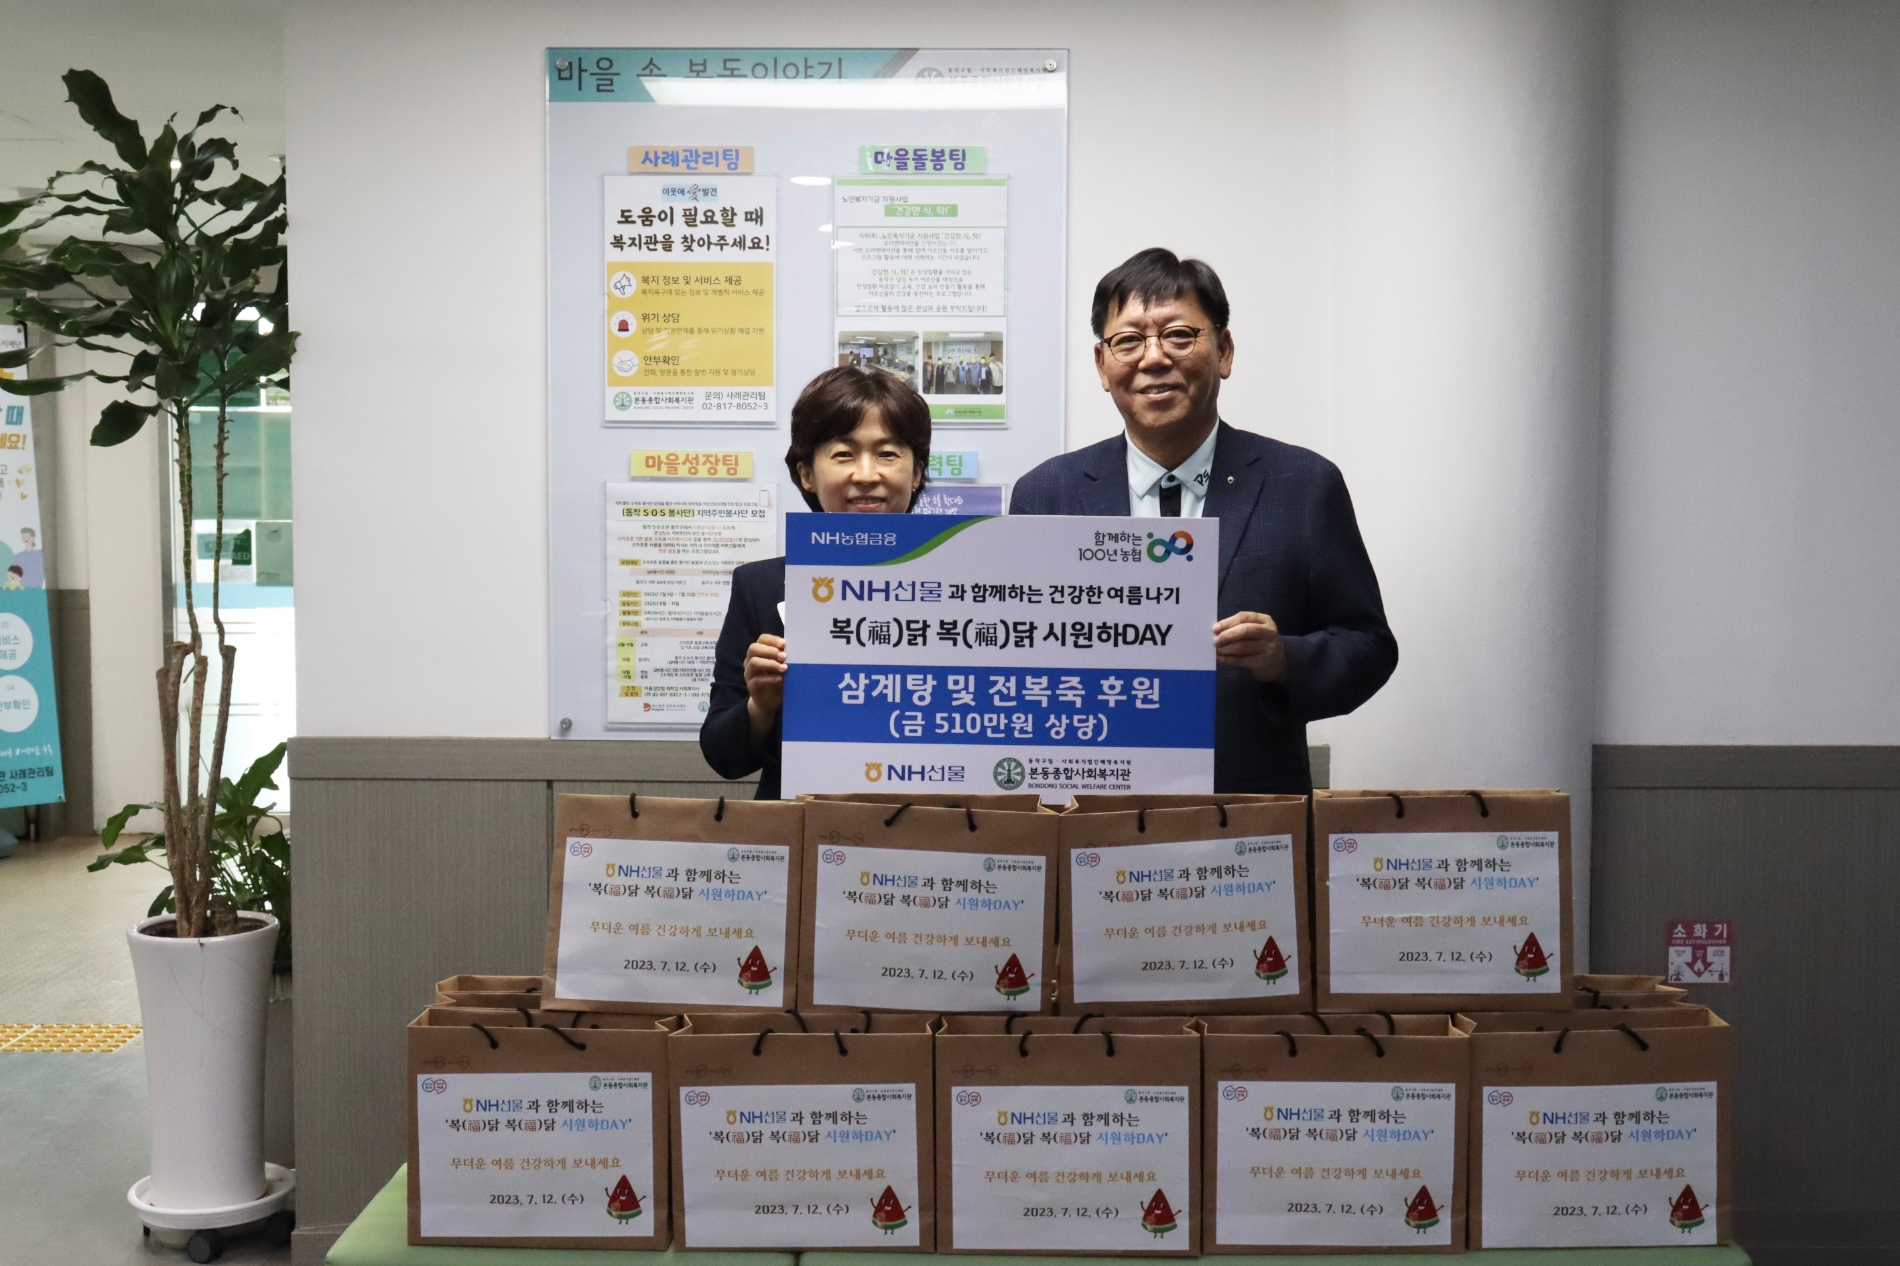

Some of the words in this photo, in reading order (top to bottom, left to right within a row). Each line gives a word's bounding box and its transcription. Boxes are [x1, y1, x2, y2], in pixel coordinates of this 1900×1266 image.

[641, 148, 740, 170] 사례관리팀
[874, 148, 966, 171] 마을돌봄팀
[702, 188, 717, 196] 발견
[617, 206, 674, 226] 도움이
[682, 206, 737, 227] 필요할
[745, 207, 763, 226] 때
[923, 206, 934, 216] 식,
[610, 234, 674, 252] 복지관을
[681, 234, 769, 252] 찾아주세요!
[641, 276, 659, 285] 복지
[662, 276, 680, 285] 정보
[683, 276, 691, 285] 및
[694, 276, 721, 285] 서비스
[724, 275, 742, 285] 제공
[642, 313, 659, 323] 위기
[662, 313, 680, 323] 상담
[712, 327, 735, 335] 위기상황
[752, 327, 764, 335] 지원
[644, 356, 680, 365] 안부확인
[705, 392, 723, 400] 문의)
[726, 391, 765, 400] 사례관리팀
[6, 406, 24, 425] 때
[645, 453, 739, 476] 마을성장팀
[751, 509, 765, 518] 모집
[811, 532, 897, 546] NH농협금융
[1094, 532, 1142, 545] 함께하는
[1079, 548, 1117, 561] 100년
[1120, 549, 1142, 562] 농협
[841, 580, 942, 603] NH선물
[971, 584, 1044, 603] 함께하는
[1049, 585, 1103, 604] 건강한
[830, 617, 928, 647] 복(福)닭
[937, 619, 1036, 648] 복(福)닭
[1043, 621, 1173, 648] 시원하DAY
[838, 673, 937, 706] 삼계탕
[947, 674, 976, 707] 및
[988, 675, 1086, 708] 전복죽
[1098, 677, 1161, 709] 후원
[890, 710, 925, 739] (금
[935, 712, 1034, 738] 510만원
[1045, 714, 1108, 741] 상당)
[10, 766, 54, 779] 사례관리팀
[888, 764, 965, 783] NH선물
[1029, 767, 1131, 782] 본동종합사회복지관
[1386, 858, 1432, 871] NH선물
[1455, 858, 1512, 871] 함께하는
[618, 865, 662, 879] NH선물
[685, 869, 741, 884] 함께하는
[1415, 878, 1464, 890] 복(福)닭
[644, 885, 693, 899] 복(福)닭
[1361, 916, 1395, 928] 무더운
[1401, 916, 1423, 928] 여름
[1429, 916, 1476, 928] 건강하게
[1481, 915, 1529, 927] 보내세요
[590, 922, 623, 934] 무더운
[629, 923, 651, 935] 여름
[656, 924, 701, 937] 건강하게
[707, 927, 755, 939] 보내세요
[1470, 952, 1492, 962] (수)
[695, 961, 716, 973] (수)
[1011, 1112, 1058, 1125] NH선물
[1082, 1113, 1139, 1127] 함께하는
[1040, 1132, 1091, 1145] 복(福)닭
[985, 1171, 1020, 1183] 무더운
[1026, 1171, 1049, 1182] 여름
[1054, 1171, 1102, 1183] 건강하게
[1107, 1171, 1157, 1183] 보내세요
[1096, 1207, 1118, 1219] (수)
